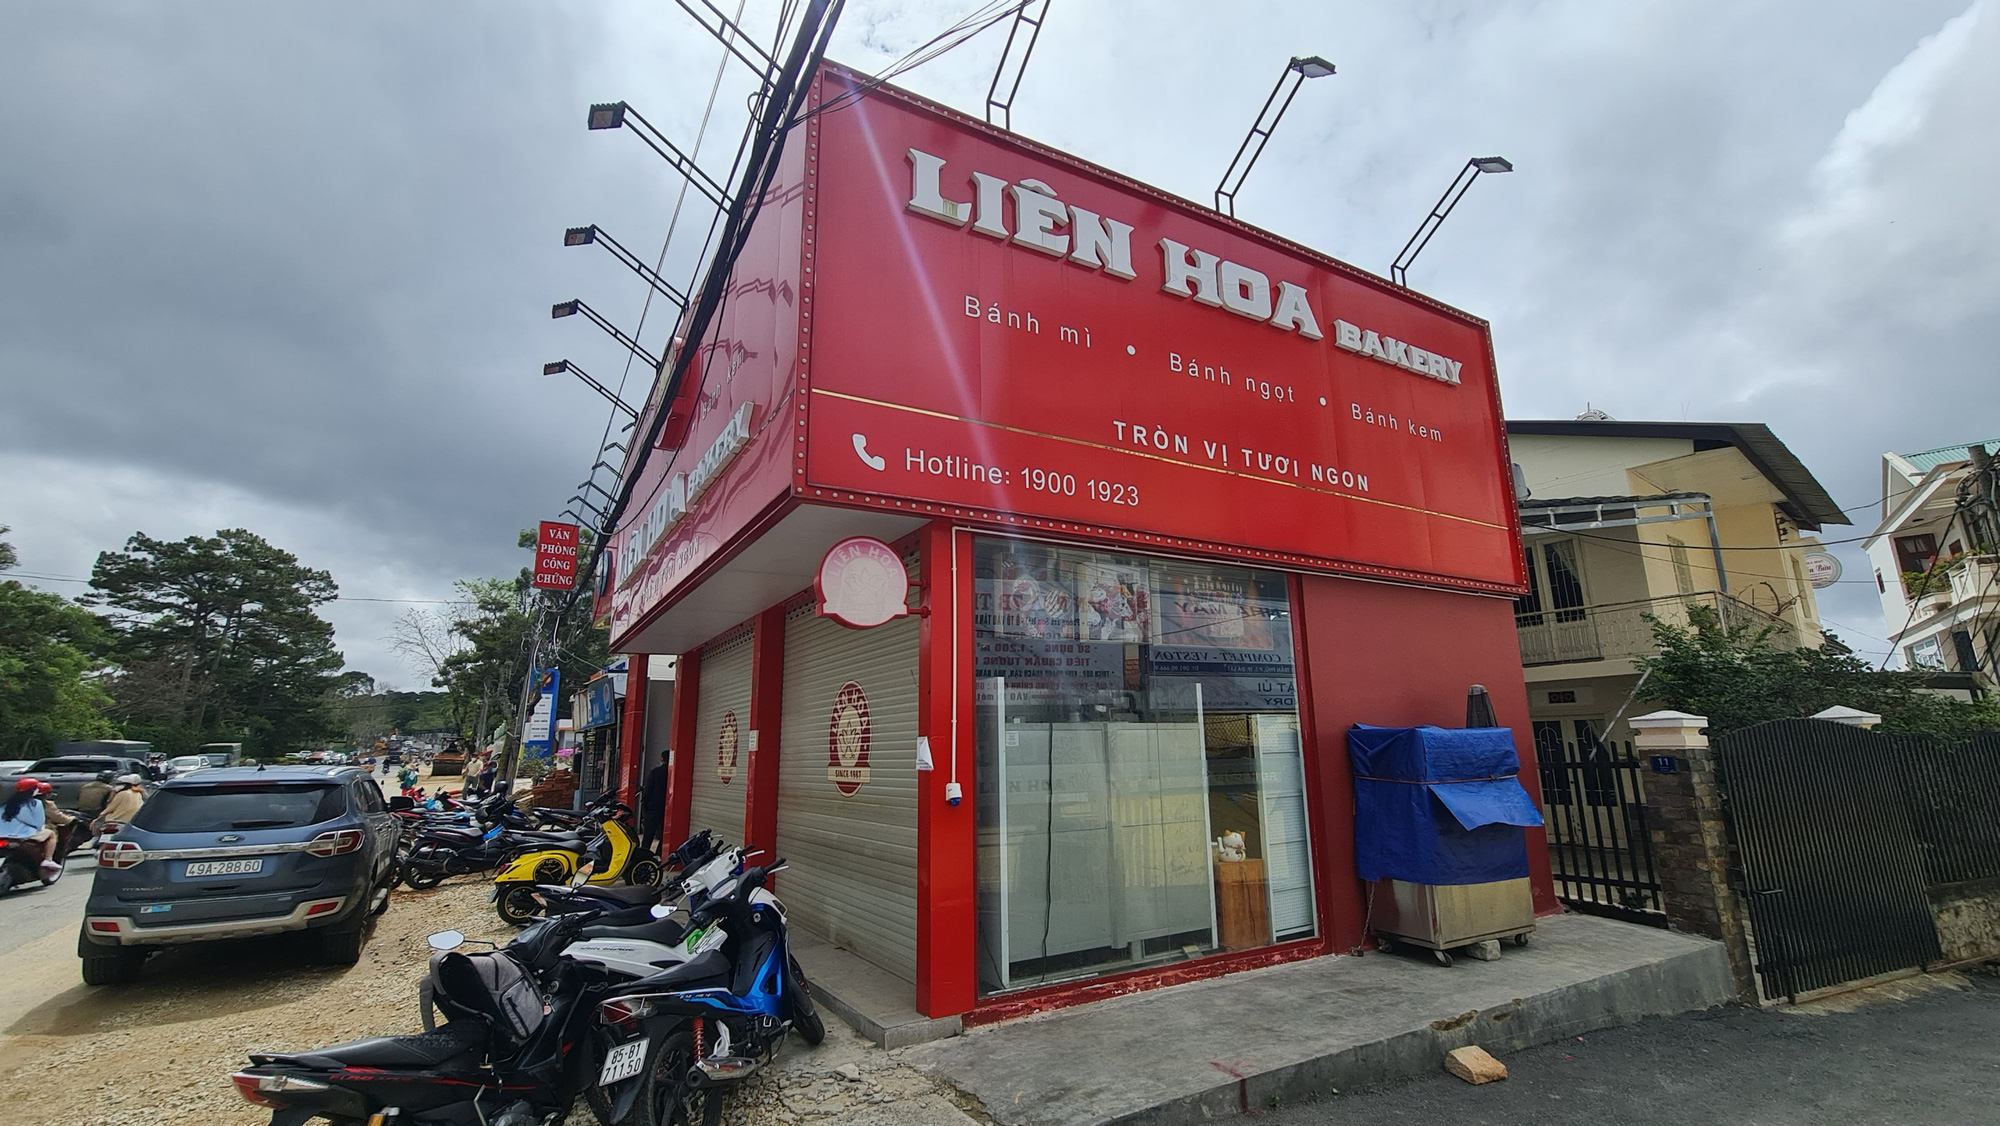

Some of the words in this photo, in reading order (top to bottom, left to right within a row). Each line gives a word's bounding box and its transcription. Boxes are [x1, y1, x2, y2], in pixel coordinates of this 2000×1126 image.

[906, 147, 1138, 281] LIÊN
[1158, 237, 1325, 341] HOA
[1332, 317, 1464, 386] BAKERY
[964, 295, 1040, 335] Bánh
[1060, 325, 1092, 348] mì
[1169, 352, 1232, 386] Bánh
[1245, 375, 1295, 404] ngọt
[1351, 403, 1399, 431] Bánh
[1408, 419, 1443, 443] kem
[1113, 420, 1189, 454] TRÒN
[1203, 440, 1228, 467] VỊ
[1241, 448, 1298, 477] TƯƠI
[1312, 463, 1369, 492] NGON
[905, 447, 1010, 485] Hotline:
[1021, 467, 1077, 497] 1900
[1087, 479, 1139, 507] 1923
[549, 527, 570, 540] VĂN
[540, 542, 576, 556] PHÒNG
[542, 557, 570, 570] CÔNG
[868, 545, 898, 578] HOA
[536, 572, 573, 585] CHỨNG
[1657, 758, 1669, 766] 11
[187, 860, 261, 876] 49A-288.60
[611, 1042, 641, 1065] 85-B1
[602, 1058, 642, 1084] 711.50
